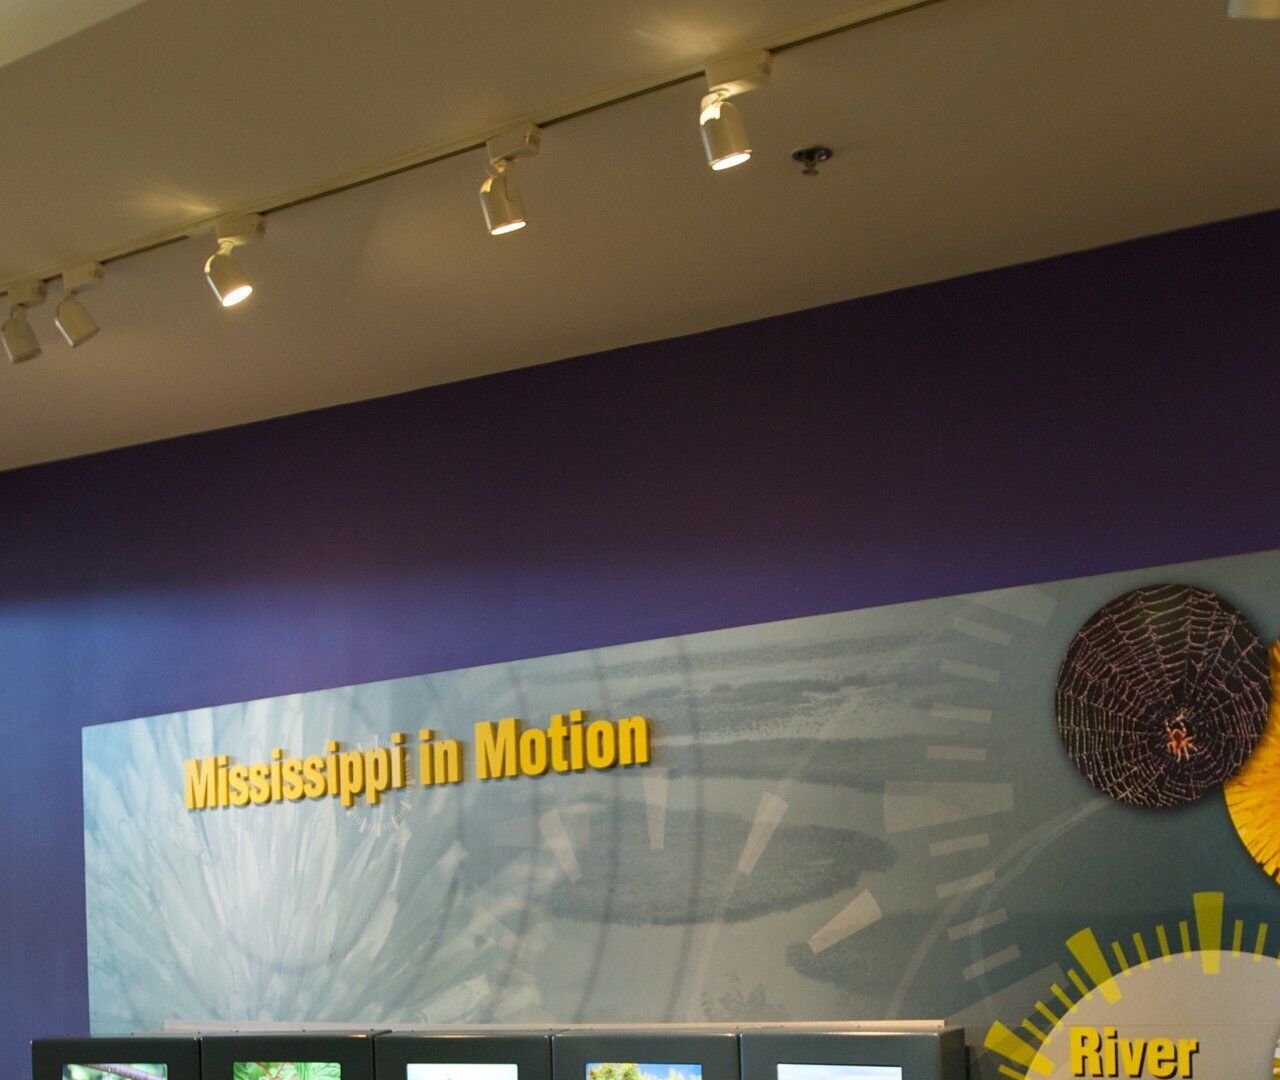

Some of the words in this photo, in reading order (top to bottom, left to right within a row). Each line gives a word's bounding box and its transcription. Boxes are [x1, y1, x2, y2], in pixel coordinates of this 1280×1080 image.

[184, 732, 408, 809] Mississippi
[419, 729, 463, 786] in
[475, 709, 651, 779] Motion
[1069, 1026, 1199, 1079] River
